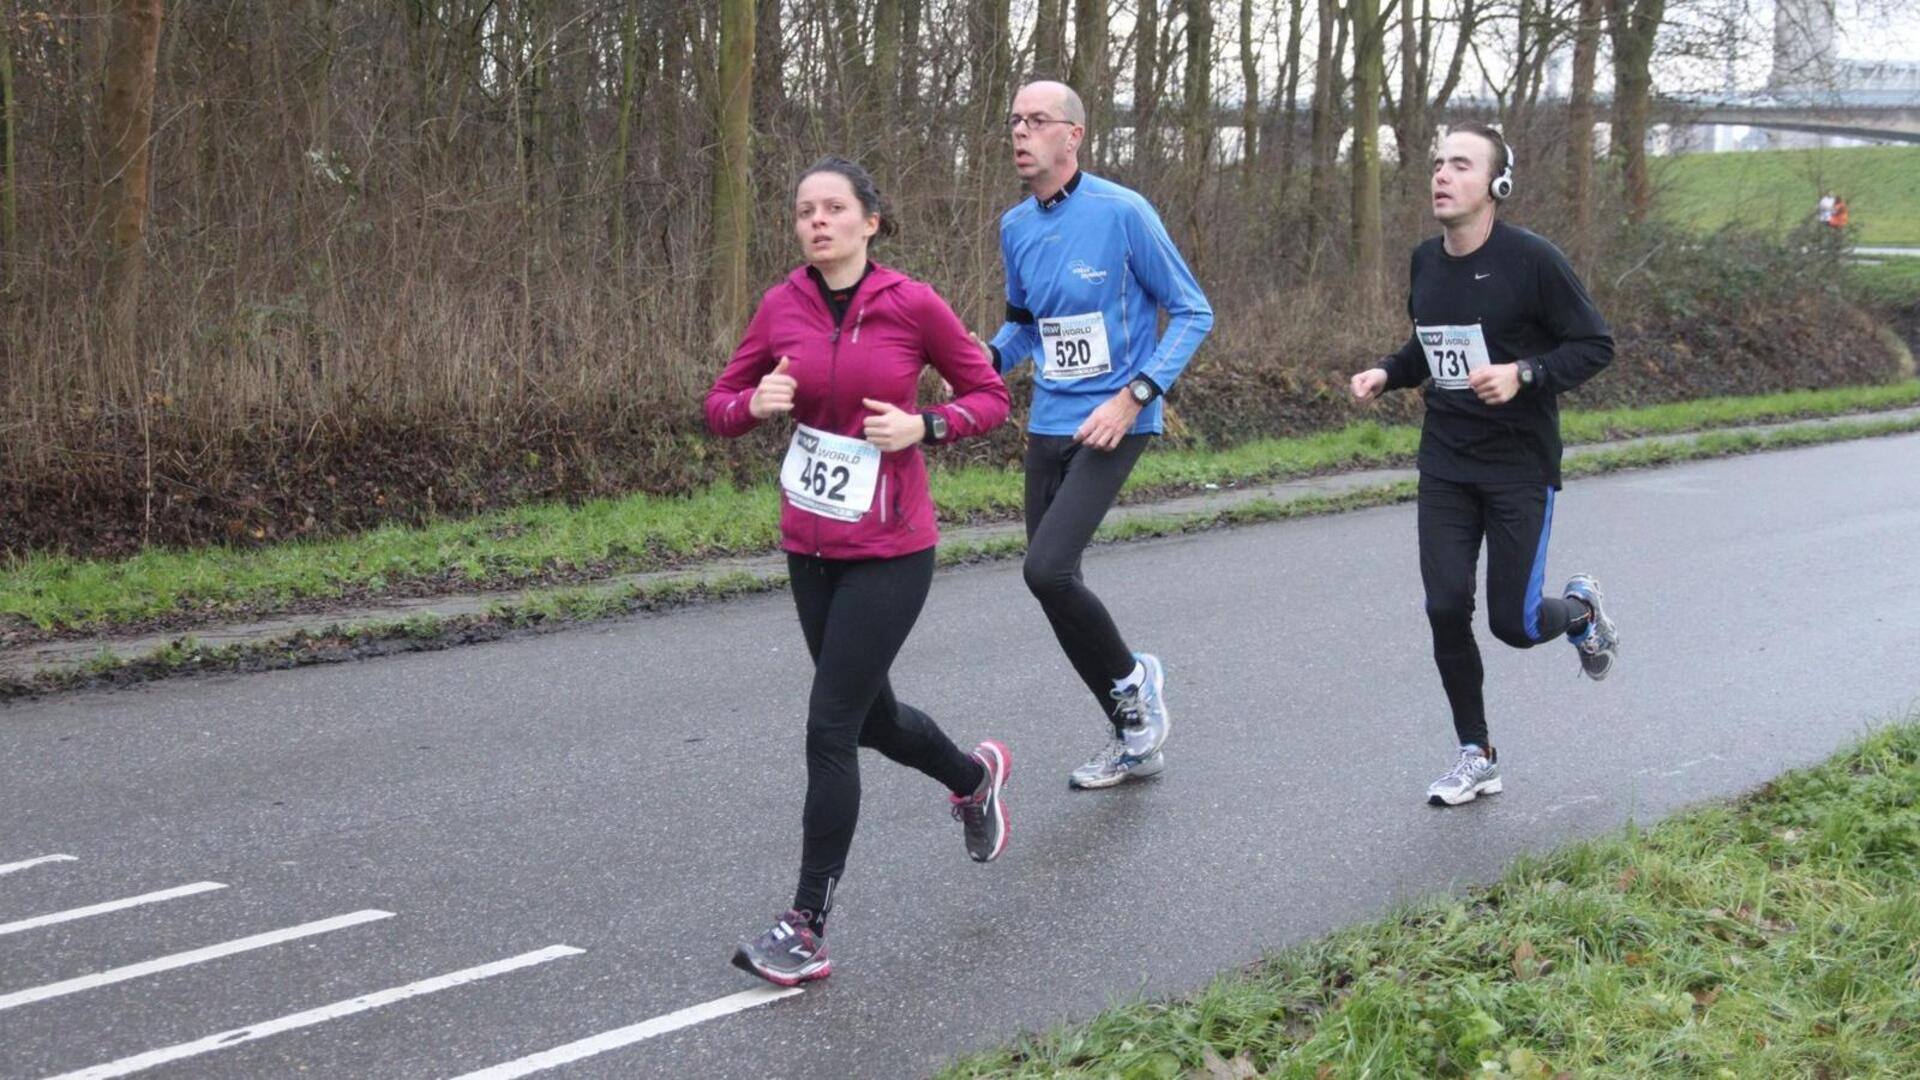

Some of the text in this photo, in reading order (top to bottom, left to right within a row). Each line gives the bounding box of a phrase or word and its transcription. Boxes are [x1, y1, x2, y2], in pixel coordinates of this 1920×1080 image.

[1056, 338, 1091, 367] 520
[1433, 350, 1470, 377] 731
[817, 448, 861, 465] WORLD
[800, 456, 849, 502] 462
